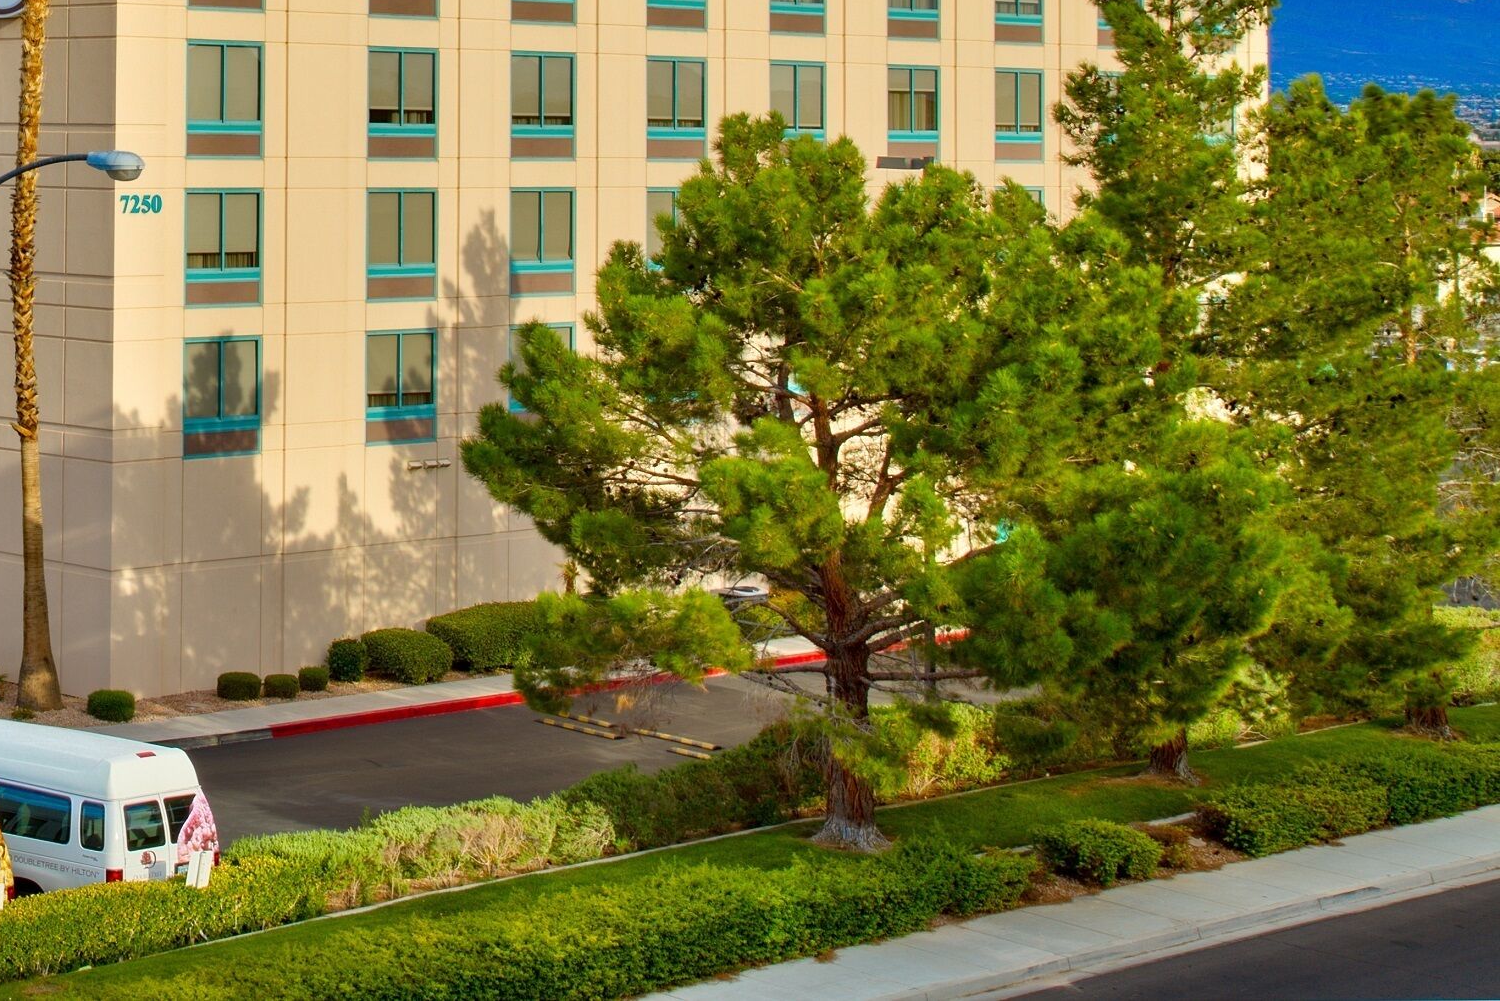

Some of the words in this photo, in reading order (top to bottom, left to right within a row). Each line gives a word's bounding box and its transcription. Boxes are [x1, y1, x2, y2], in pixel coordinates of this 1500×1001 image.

[119, 194, 163, 214] 7250
[13, 854, 60, 871] DOUBLETREE
[60, 864, 70, 873] BY
